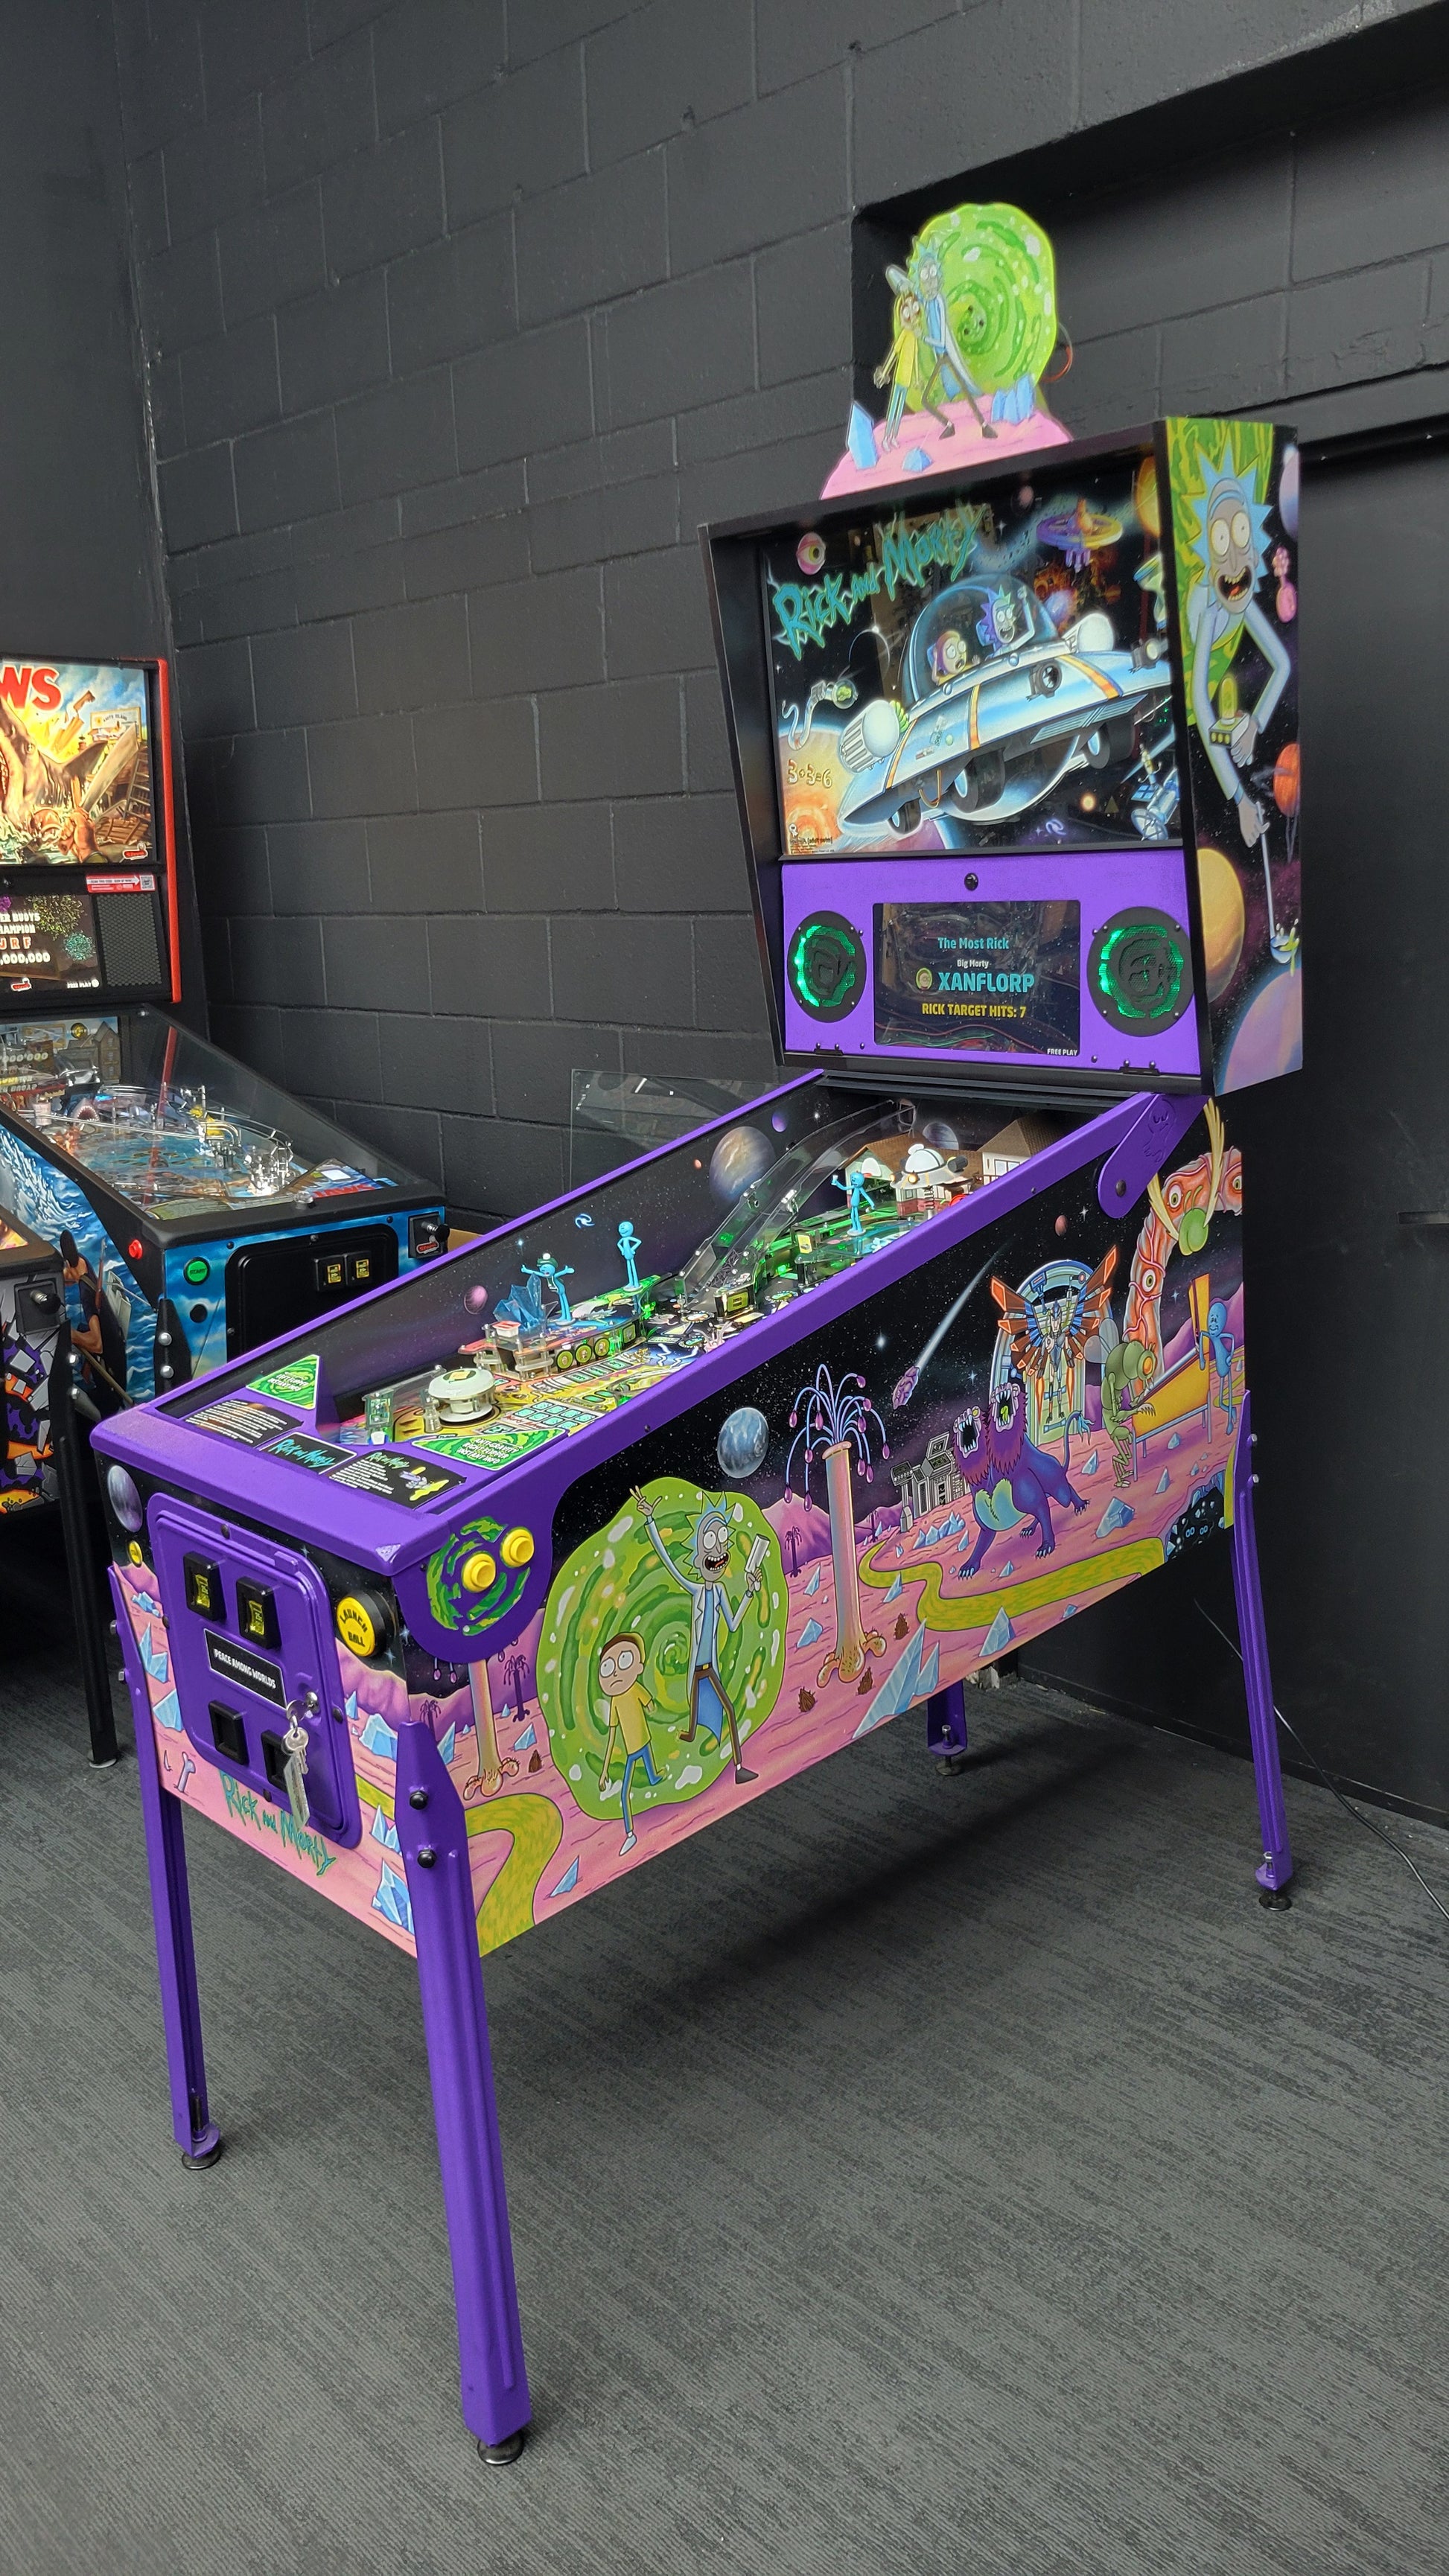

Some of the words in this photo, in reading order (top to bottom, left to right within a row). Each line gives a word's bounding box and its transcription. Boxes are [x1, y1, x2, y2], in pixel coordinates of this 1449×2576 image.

[12, 913, 40, 922] BUOYS
[937, 937, 957, 949] The
[958, 937, 984, 949] Most
[987, 937, 1010, 950] Rick
[957, 959, 969, 969] Big
[969, 959, 990, 969] Morty
[937, 972, 1035, 993] XANFLORP
[922, 1003, 945, 1016] RICK
[948, 1004, 987, 1017] TARGET
[990, 1005, 1016, 1018] HITS:
[1019, 1006, 1027, 1018] 7
[340, 1609, 368, 1633] LAUNCH
[347, 1630, 366, 1648] BALL
[214, 1648, 232, 1665] PEACE
[232, 1657, 252, 1676] AMONG
[252, 1668, 276, 1689] WORLDS
